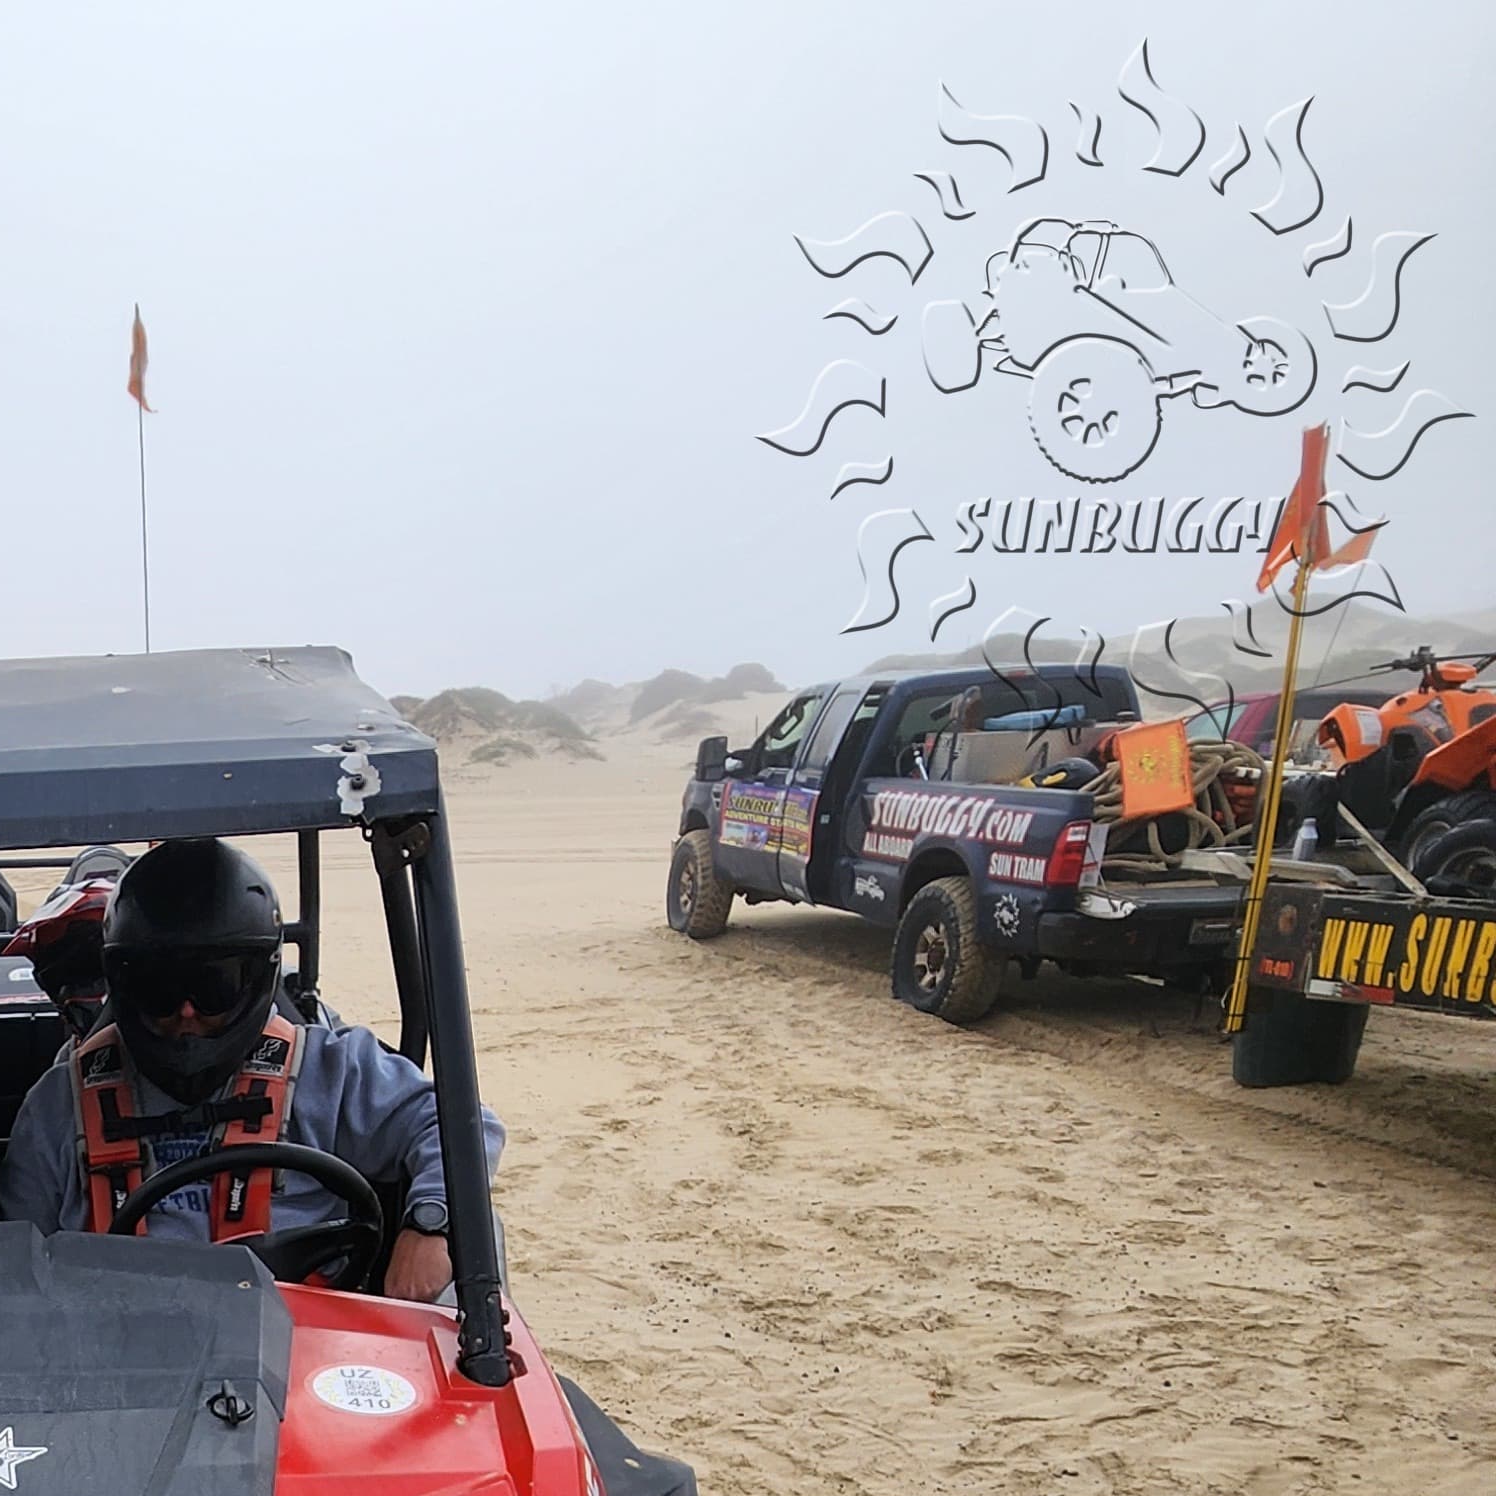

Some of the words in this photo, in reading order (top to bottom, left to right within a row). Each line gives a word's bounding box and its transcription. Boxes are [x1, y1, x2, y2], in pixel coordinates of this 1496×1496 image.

[864, 831, 878, 852] ALL
[990, 852, 1012, 877] SUN
[1013, 855, 1046, 883] TRAM
[1318, 912, 1496, 1006] WWW.SUNB
[340, 1368, 373, 1379] UZ
[348, 1397, 391, 1409] 410
